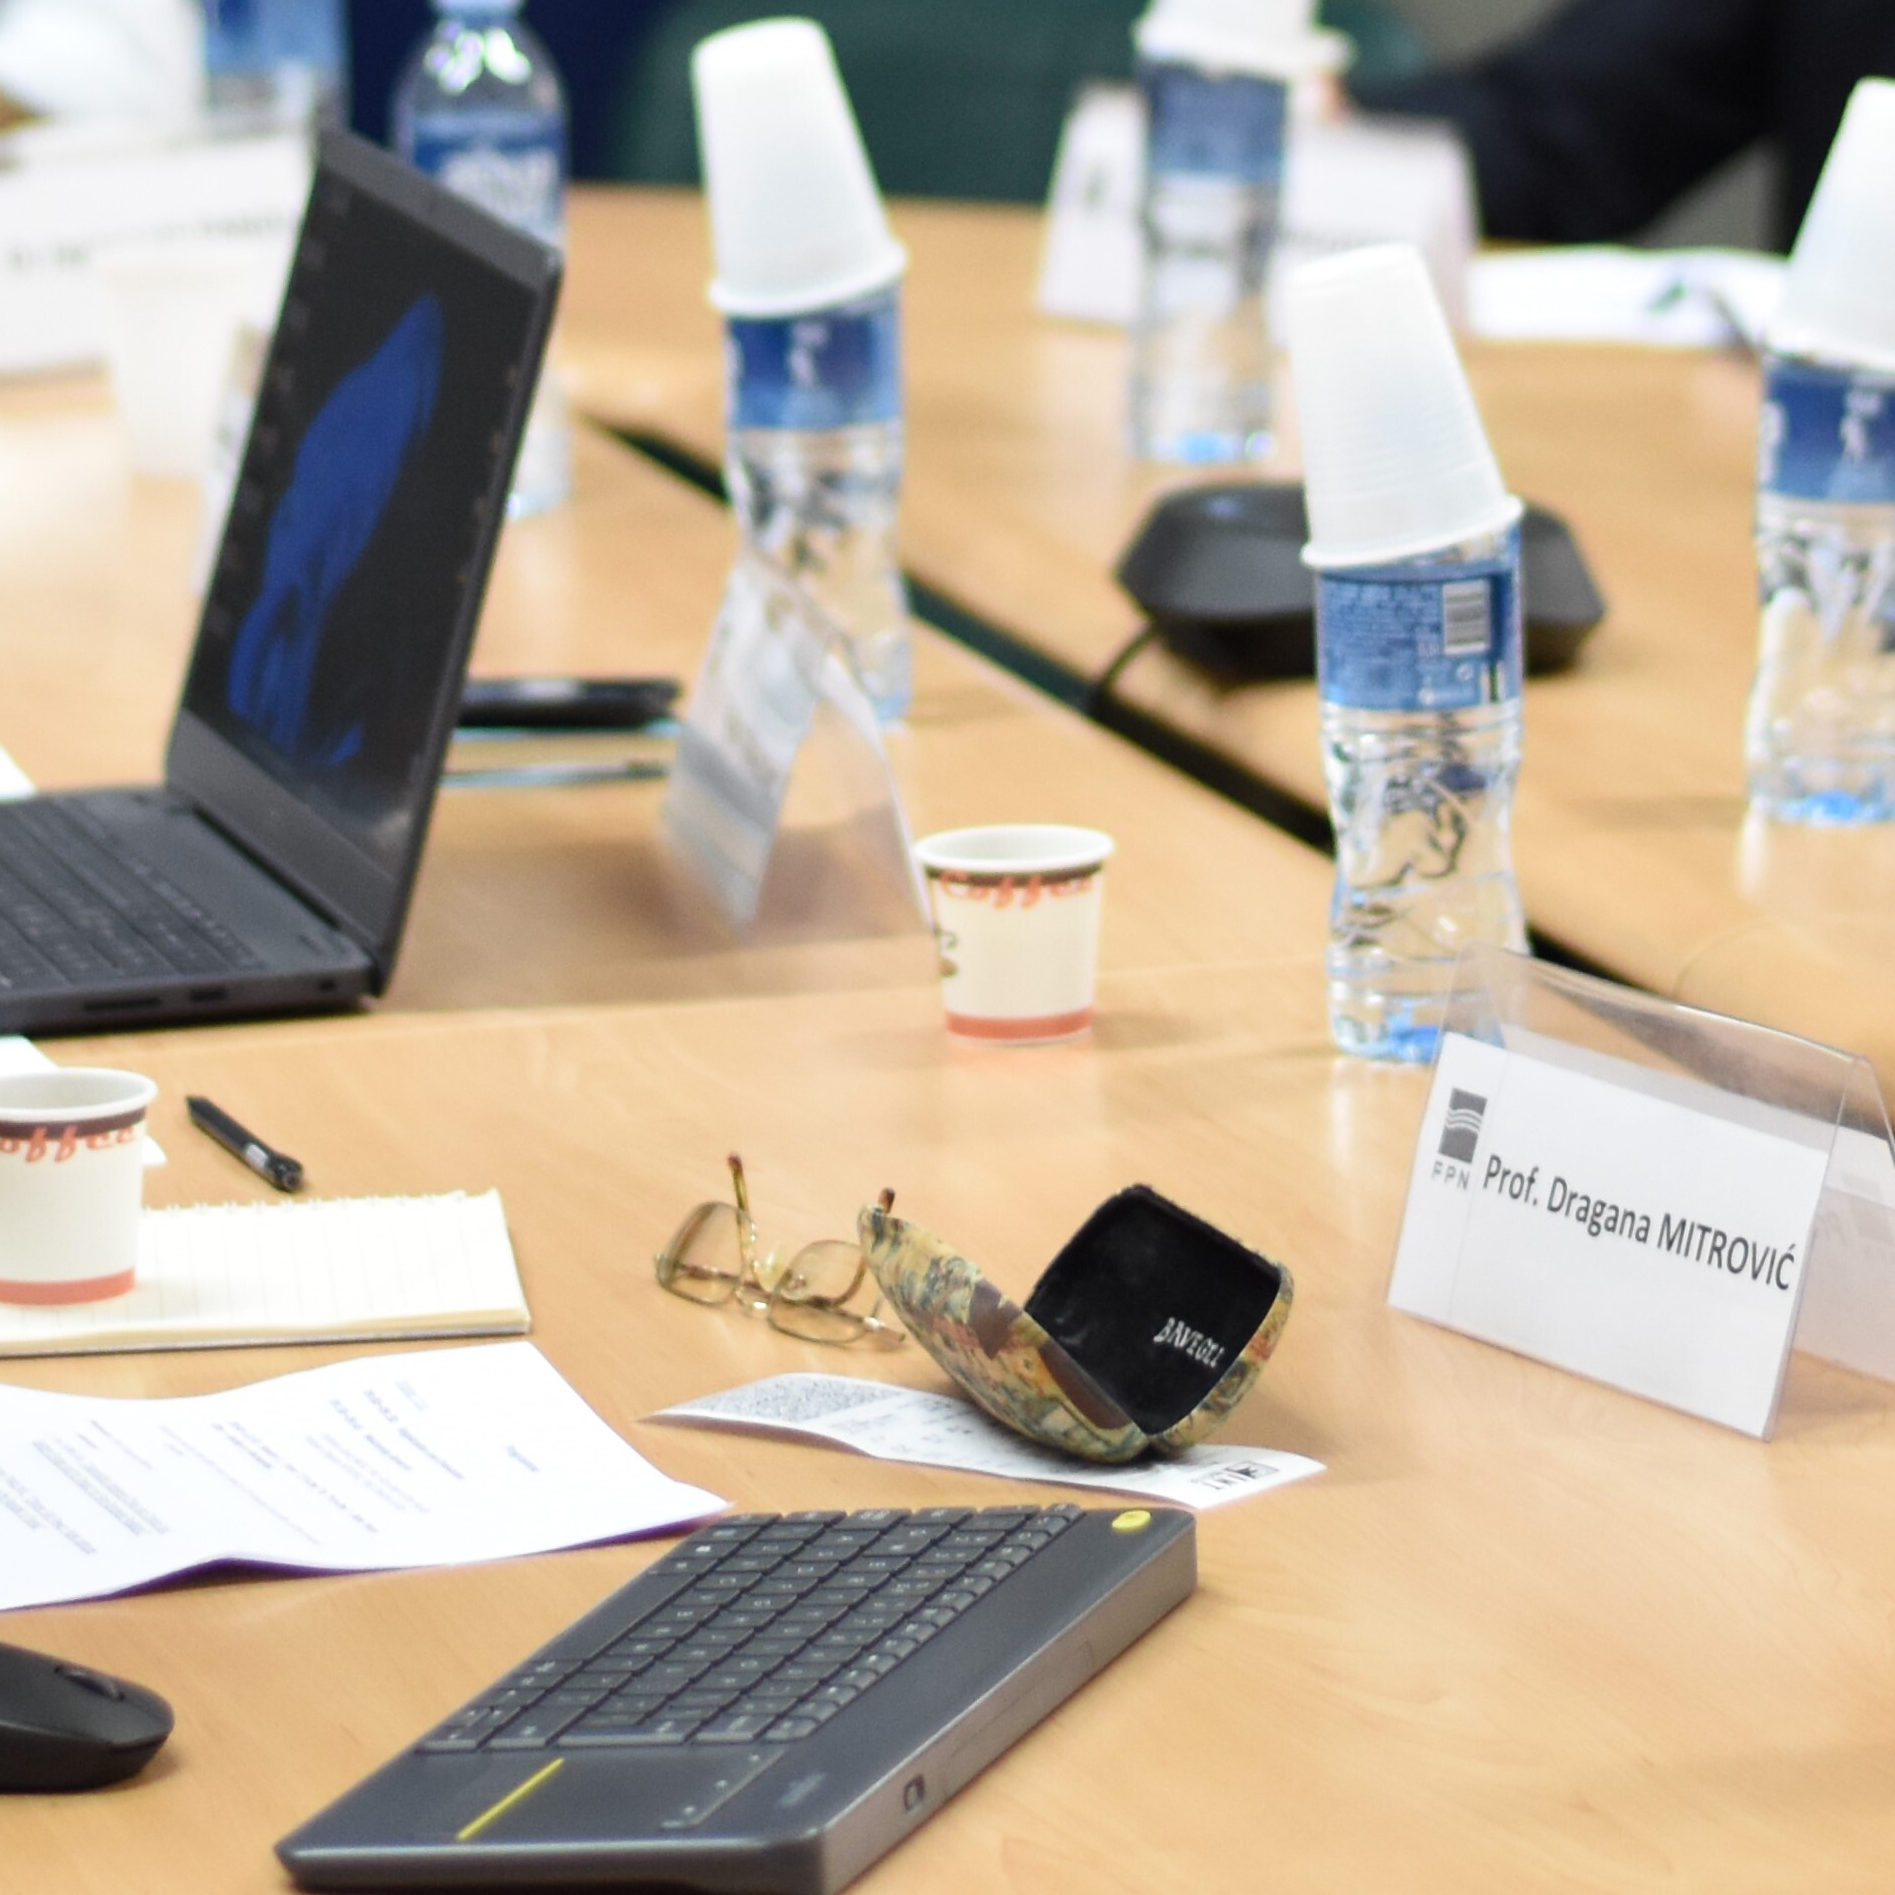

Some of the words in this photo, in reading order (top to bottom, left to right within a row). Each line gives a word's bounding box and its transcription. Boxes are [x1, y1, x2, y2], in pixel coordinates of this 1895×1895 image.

[1432, 1160, 1470, 1191] FPN
[1483, 1153, 1539, 1207] Prof.
[1547, 1175, 1652, 1243] Dragana
[1657, 1210, 1796, 1291] MITROVIĆ
